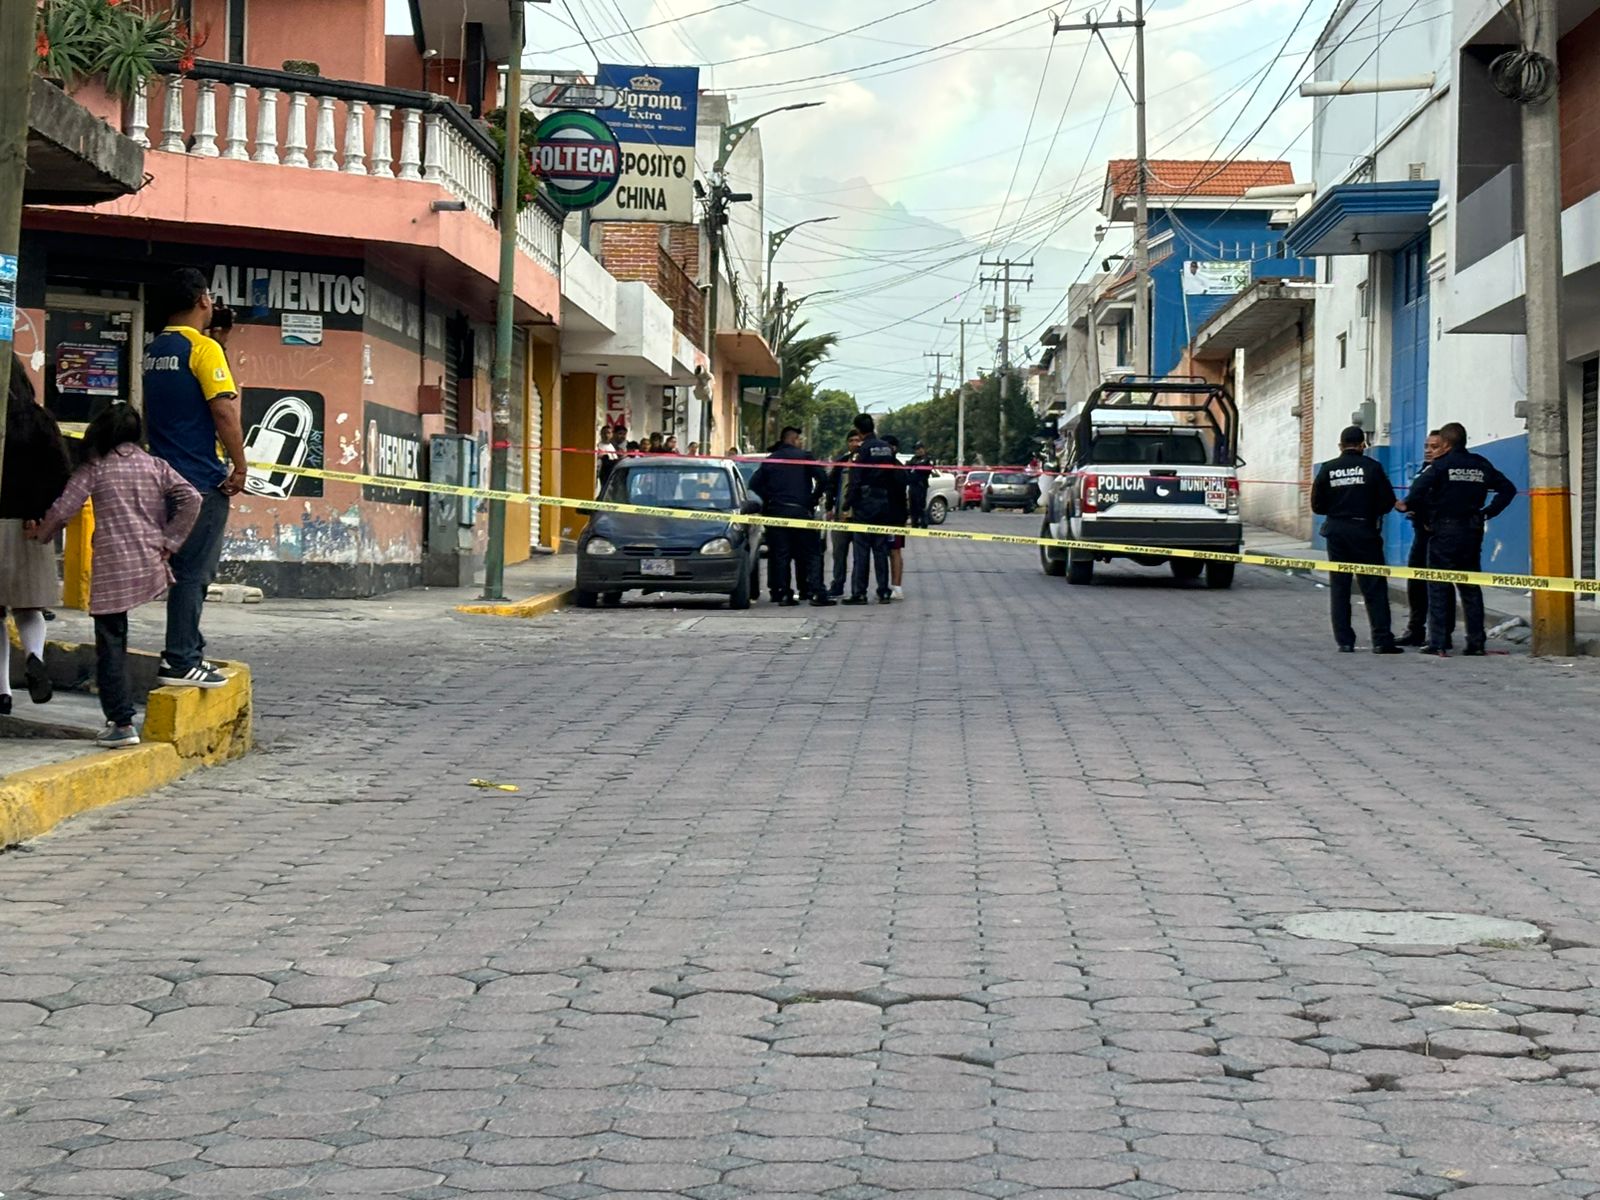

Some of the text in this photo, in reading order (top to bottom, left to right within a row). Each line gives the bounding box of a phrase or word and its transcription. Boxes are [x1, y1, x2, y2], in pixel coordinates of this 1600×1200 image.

[613, 88, 683, 111] Corona
[628, 111, 662, 121] Extra
[530, 146, 615, 174] TOLTECA
[620, 152, 687, 179] EPOSITO
[616, 185, 667, 212] CHINA
[211, 264, 366, 316] ALIMENTOS
[1097, 475, 1227, 492] POLICIA MUNICIPAL
[1338, 564, 1391, 576] PRECAUCION
[1414, 570, 1469, 582] PRECAUCION
[1492, 575, 1549, 588] PRECAUCION
